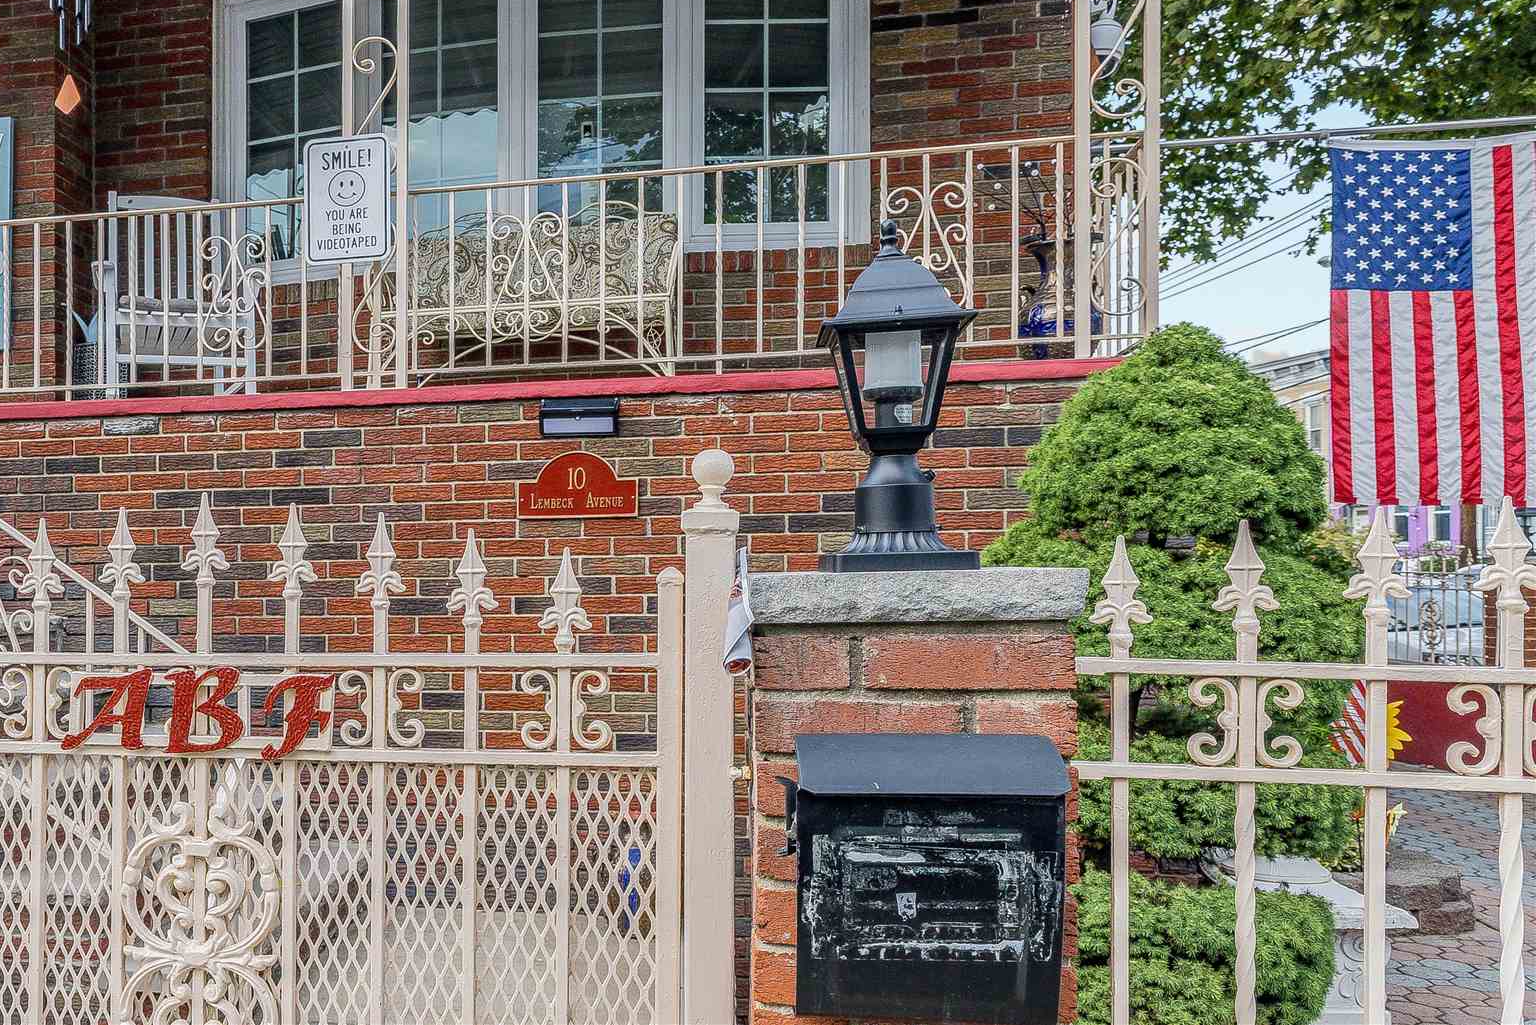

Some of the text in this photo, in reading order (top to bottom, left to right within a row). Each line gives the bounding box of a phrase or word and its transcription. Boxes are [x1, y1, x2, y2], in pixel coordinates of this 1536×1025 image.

[321, 148, 372, 171] SMILE!
[325, 207, 369, 222] YOU ARE
[332, 222, 362, 235] BEING
[316, 235, 377, 251] VIDEOTAPED
[567, 466, 586, 490] 10
[585, 491, 624, 509] AVENUE
